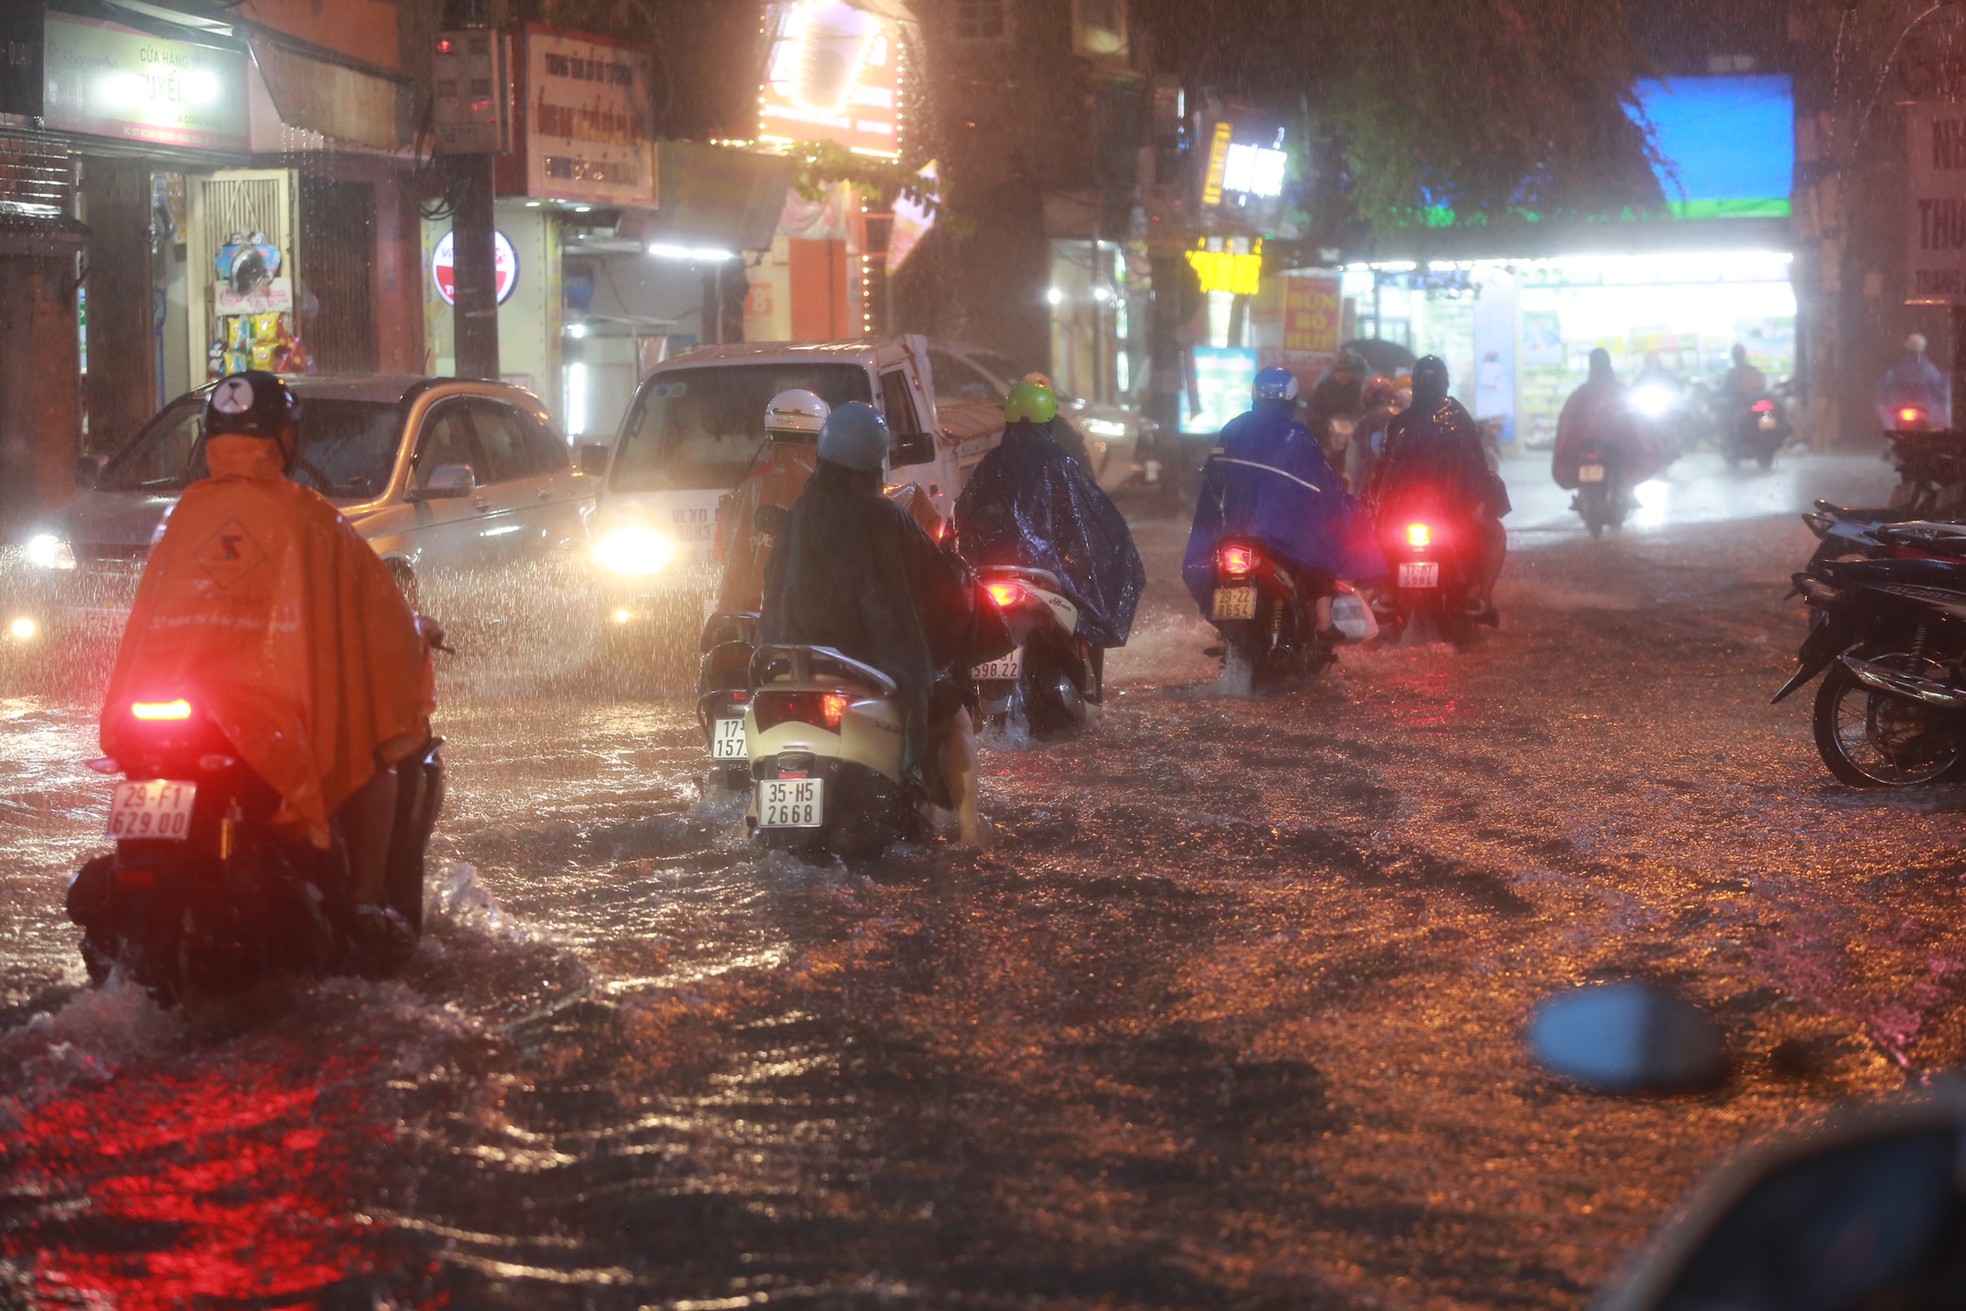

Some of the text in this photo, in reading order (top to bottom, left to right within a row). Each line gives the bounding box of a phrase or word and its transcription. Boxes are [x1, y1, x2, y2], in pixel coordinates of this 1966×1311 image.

[973, 662, 1018, 678] 598.22
[724, 720, 745, 738] 17-
[123, 785, 182, 809] 29-F1
[769, 782, 814, 803] 35-H5
[112, 811, 185, 835] 629.00
[767, 804, 813, 825] 2668
